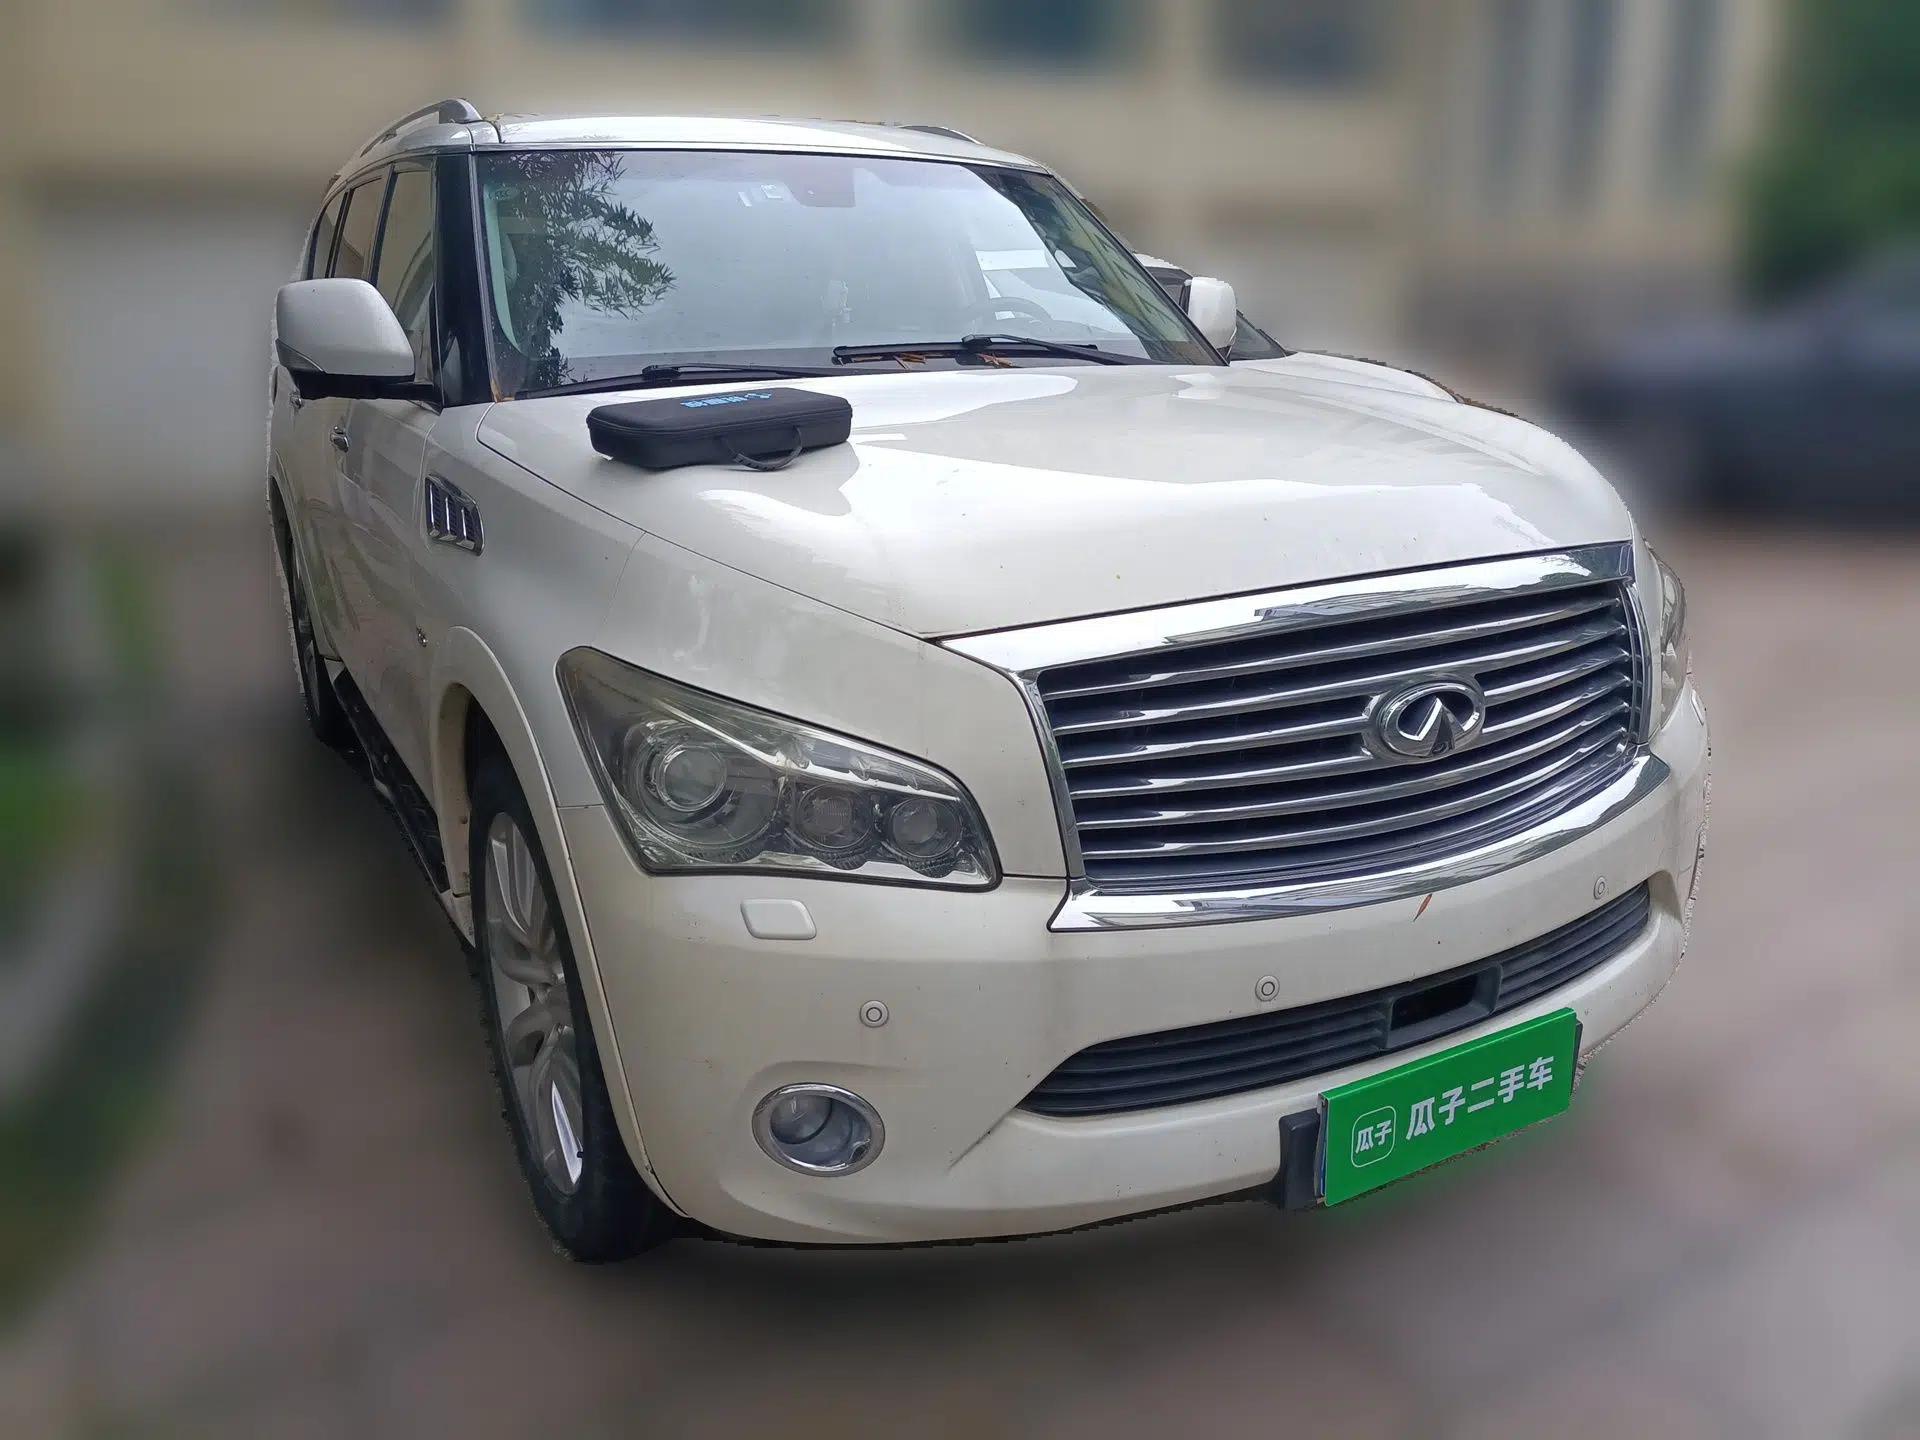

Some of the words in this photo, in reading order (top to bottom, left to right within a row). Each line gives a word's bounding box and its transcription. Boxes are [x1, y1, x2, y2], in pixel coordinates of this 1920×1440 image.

[1405, 1055, 1554, 1141] 瓜子二手车
[1355, 1119, 1392, 1154] 瓜子
